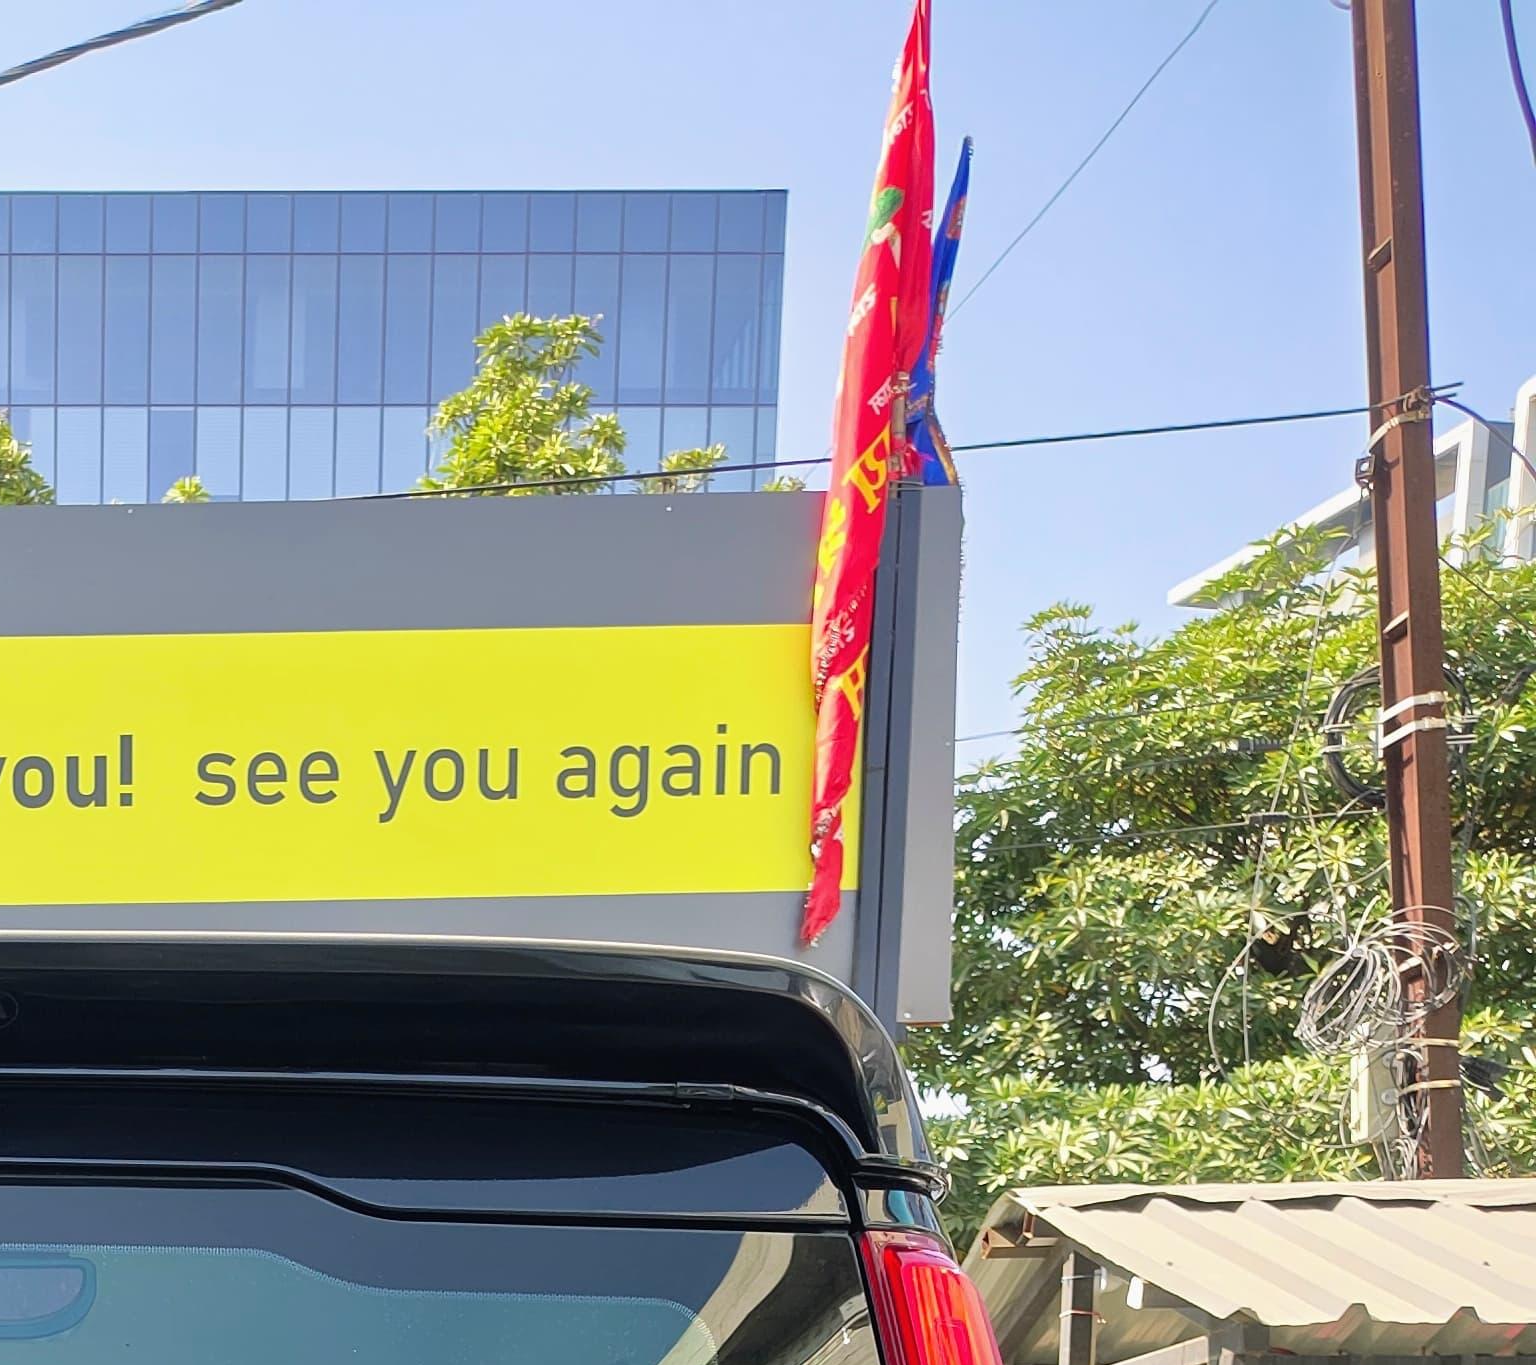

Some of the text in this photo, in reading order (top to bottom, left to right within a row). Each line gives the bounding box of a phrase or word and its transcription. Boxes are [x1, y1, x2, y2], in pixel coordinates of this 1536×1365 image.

[194, 750, 340, 806] see
[373, 747, 519, 824] you
[556, 723, 781, 818] again
